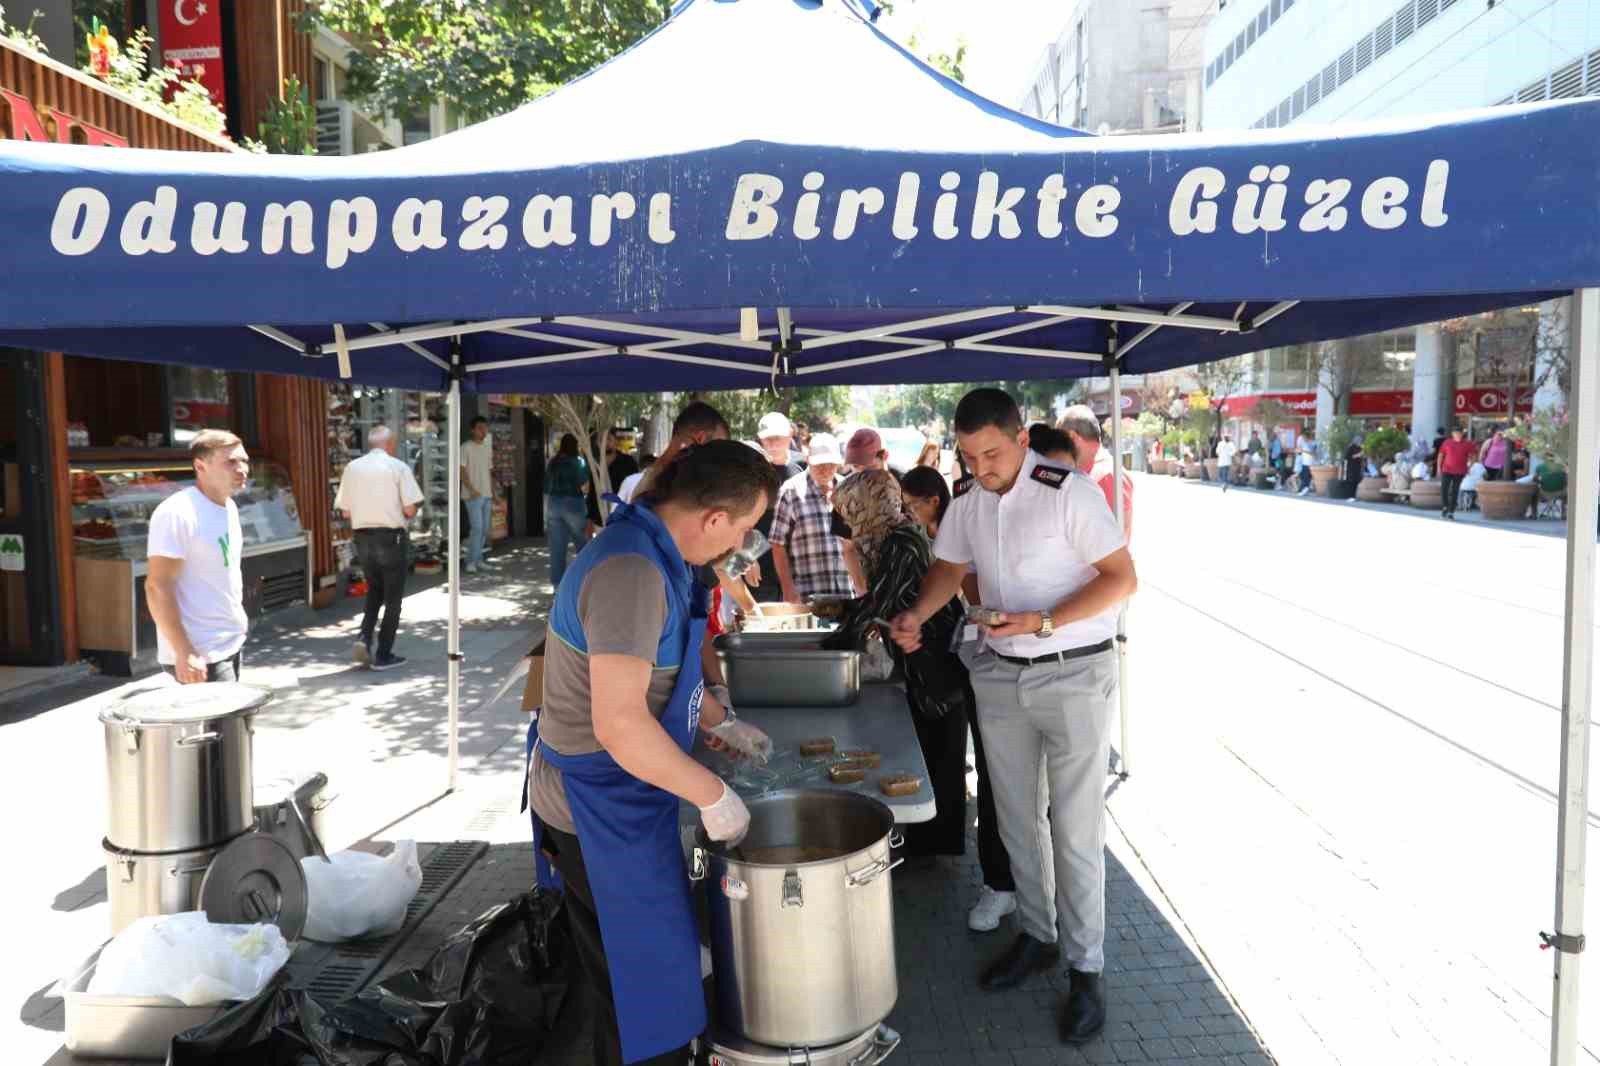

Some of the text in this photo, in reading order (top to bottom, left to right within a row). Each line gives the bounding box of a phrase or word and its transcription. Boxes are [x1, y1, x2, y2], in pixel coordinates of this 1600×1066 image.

[51, 160, 1450, 268] Odunpazarı Birlikte Güzel
